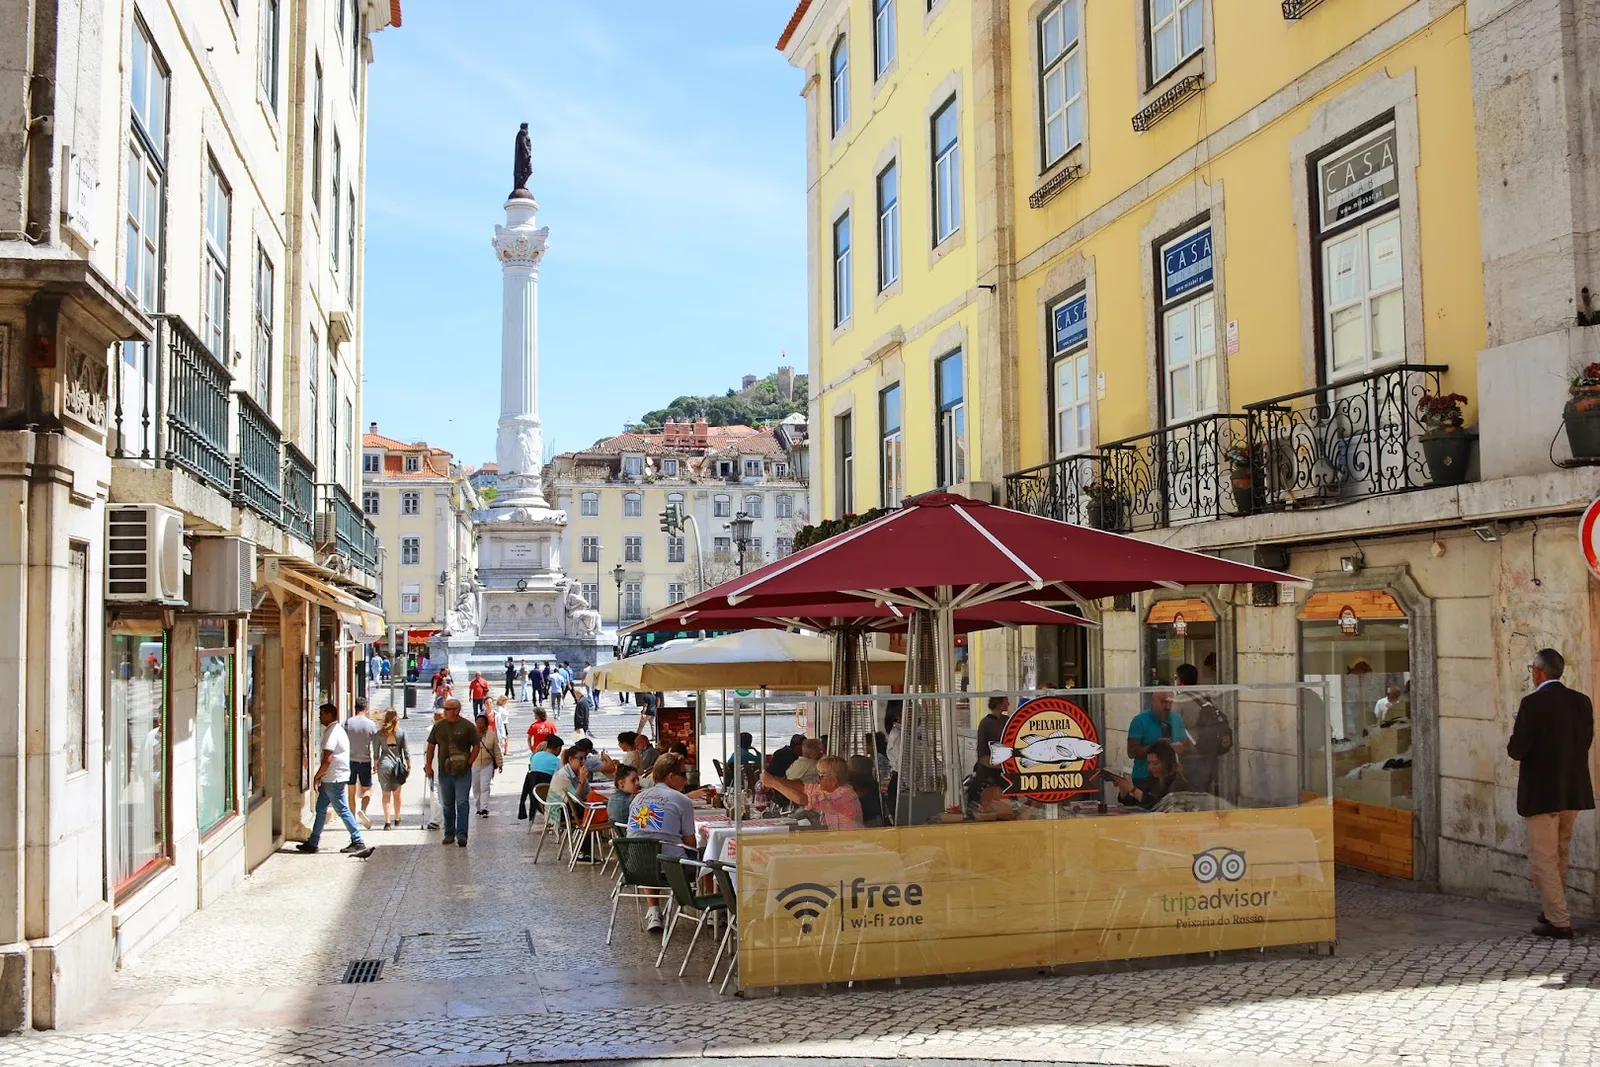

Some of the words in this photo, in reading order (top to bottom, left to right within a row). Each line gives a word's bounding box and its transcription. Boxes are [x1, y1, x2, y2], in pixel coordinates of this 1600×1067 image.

[1326, 143, 1394, 193] CASA
[1166, 237, 1212, 274] CASA
[1029, 719, 1071, 731] PEIXARIA
[1020, 775, 1038, 790] DO
[1041, 773, 1083, 789] ROSSIO
[851, 878, 923, 909] free
[1161, 888, 1271, 916] tripadvisor
[851, 914, 884, 929] wi-fi
[888, 914, 924, 927] zone
[1176, 917, 1215, 928] Peixaria
[1218, 916, 1230, 926] do
[1233, 914, 1264, 925] Rossio
